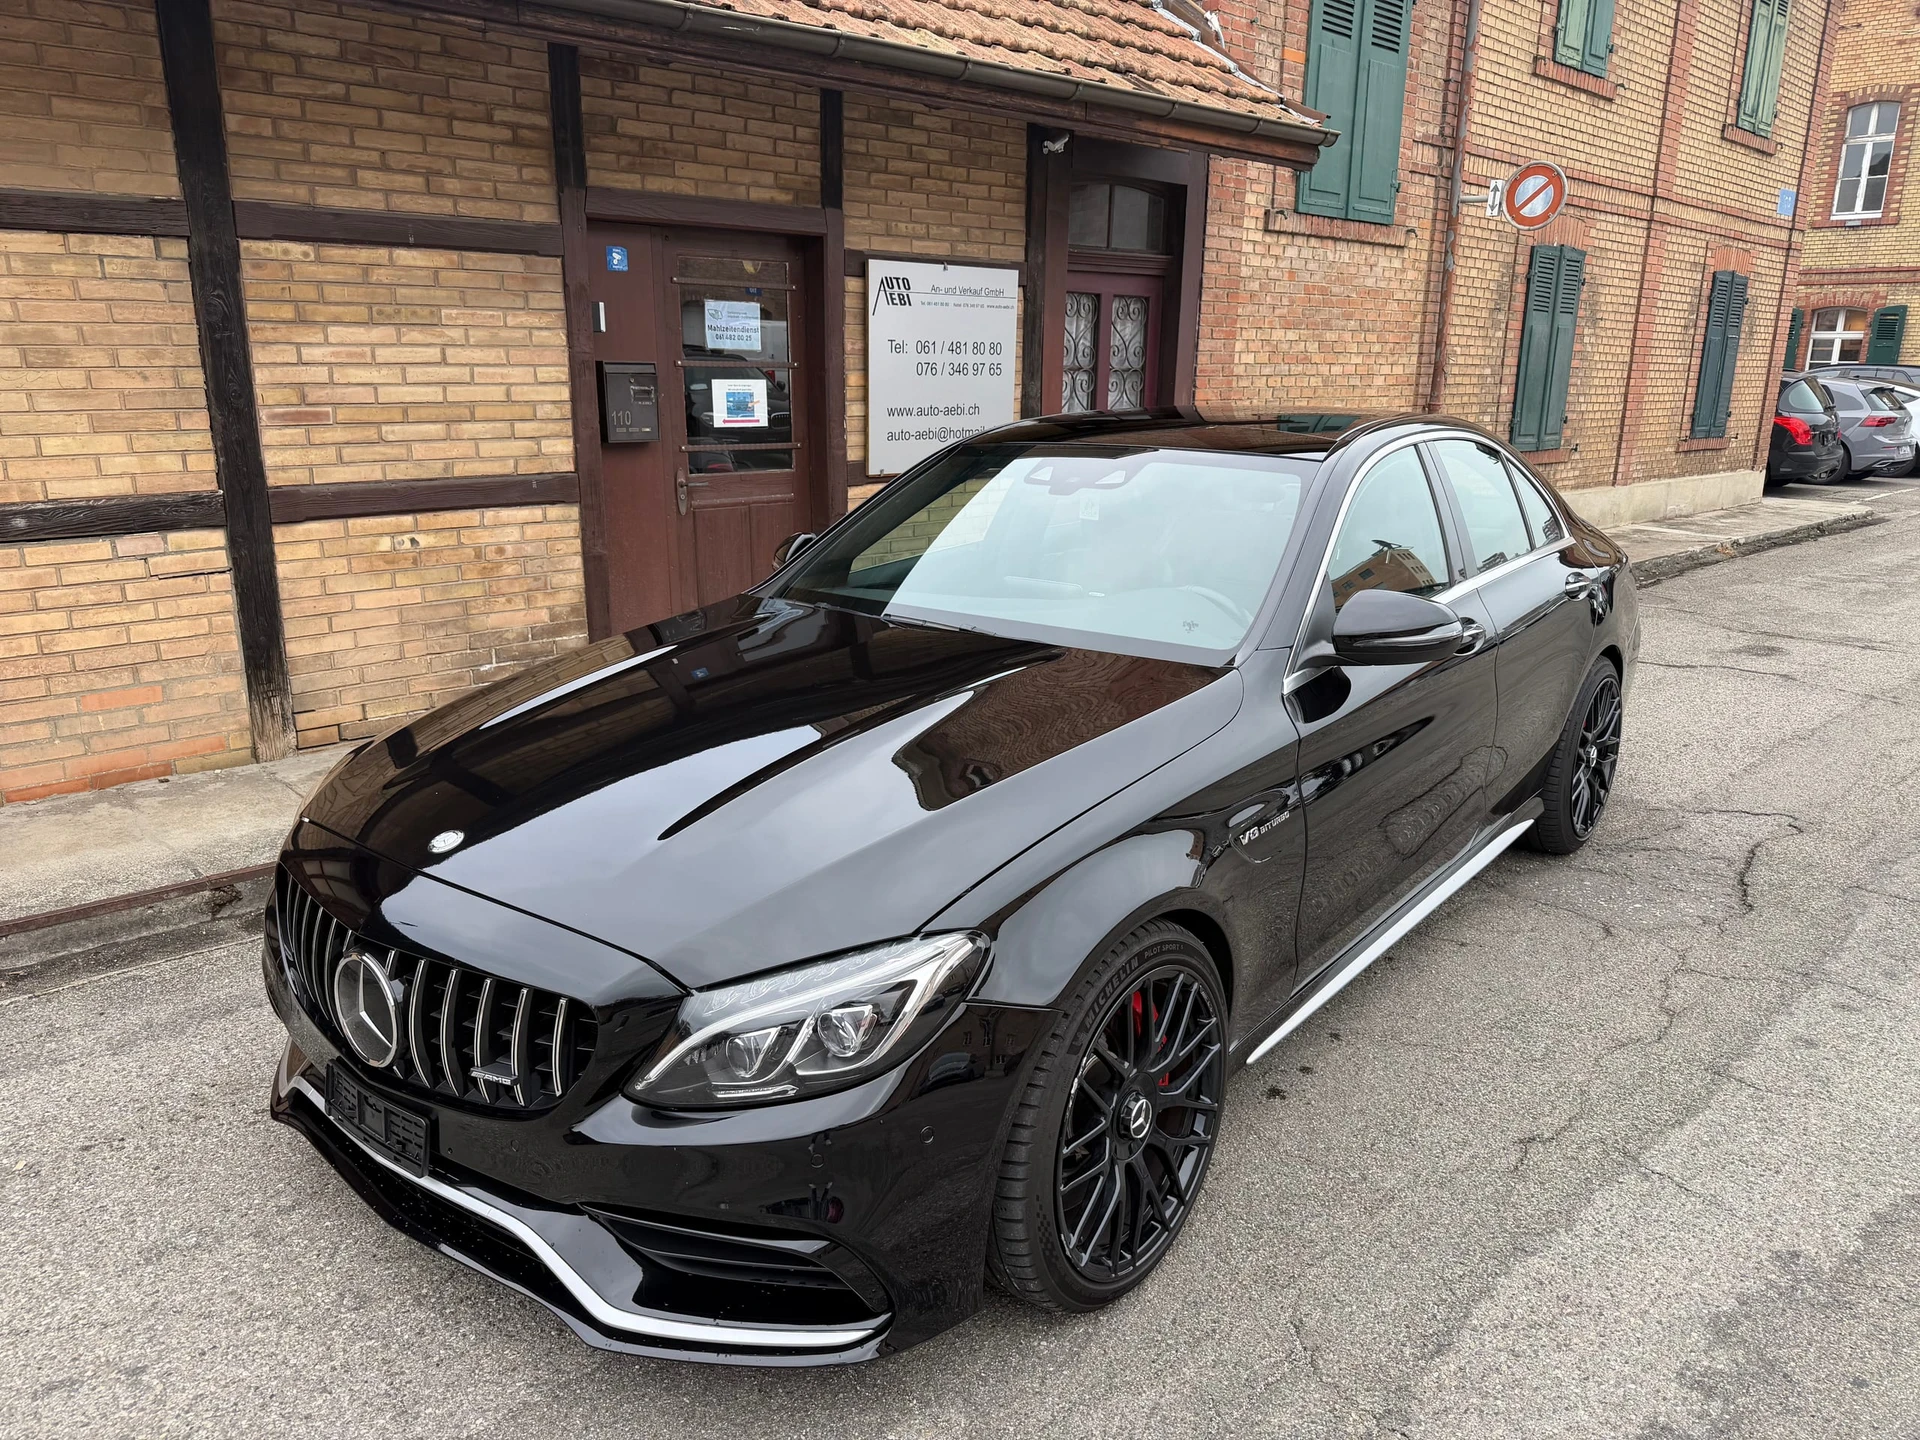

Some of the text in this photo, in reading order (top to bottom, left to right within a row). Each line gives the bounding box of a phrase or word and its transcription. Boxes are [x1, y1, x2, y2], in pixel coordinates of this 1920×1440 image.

[930, 284, 1005, 297] An- und Verkauf GmbH
[707, 324, 760, 334] Mahlzeitendienst
[715, 333, 725, 341] 061
[745, 334, 753, 342] 25
[887, 339, 1003, 356] Tel: 061 / 481 80 80
[916, 361, 1003, 377] 076 / 346 97 65
[611, 410, 632, 426] 110
[886, 403, 980, 417] www.auto-aebi.ch
[1239, 810, 1291, 846] V8 BITURBO
[1144, 945, 1161, 959] PILOT
[1161, 943, 1180, 952] SPORT
[1084, 956, 1140, 1029] MICHELIN
[483, 1073, 511, 1086] AMG
